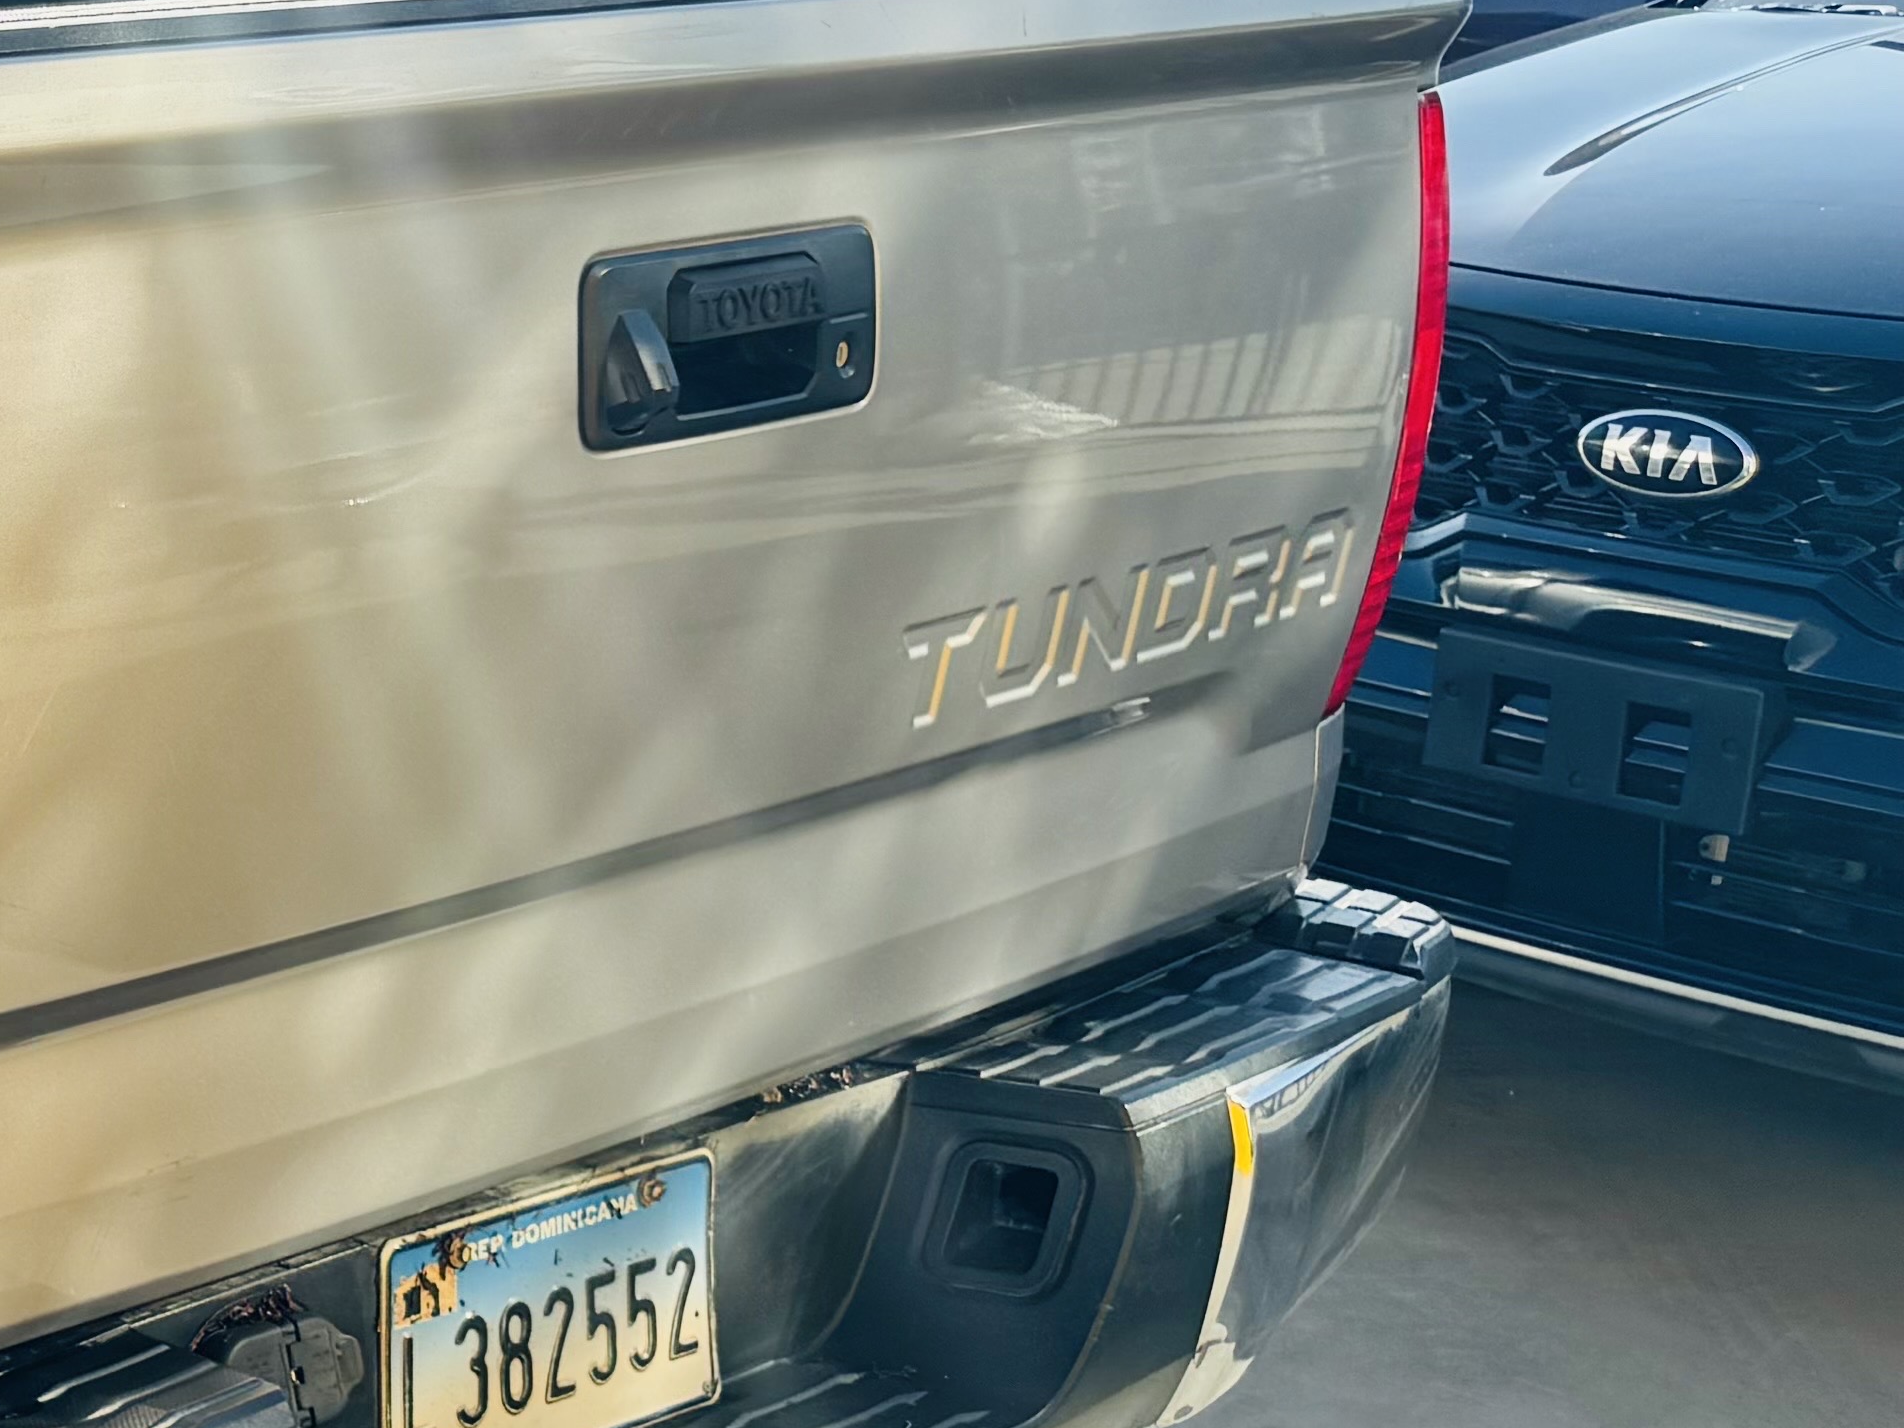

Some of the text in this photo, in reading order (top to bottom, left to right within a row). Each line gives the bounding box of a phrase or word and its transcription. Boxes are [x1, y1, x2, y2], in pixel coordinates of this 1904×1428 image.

[695, 276, 826, 333] TOYOTA
[1600, 422, 1718, 486] KIA
[903, 506, 1355, 730] TUNDRA
[511, 1192, 640, 1250] DOMINICANA
